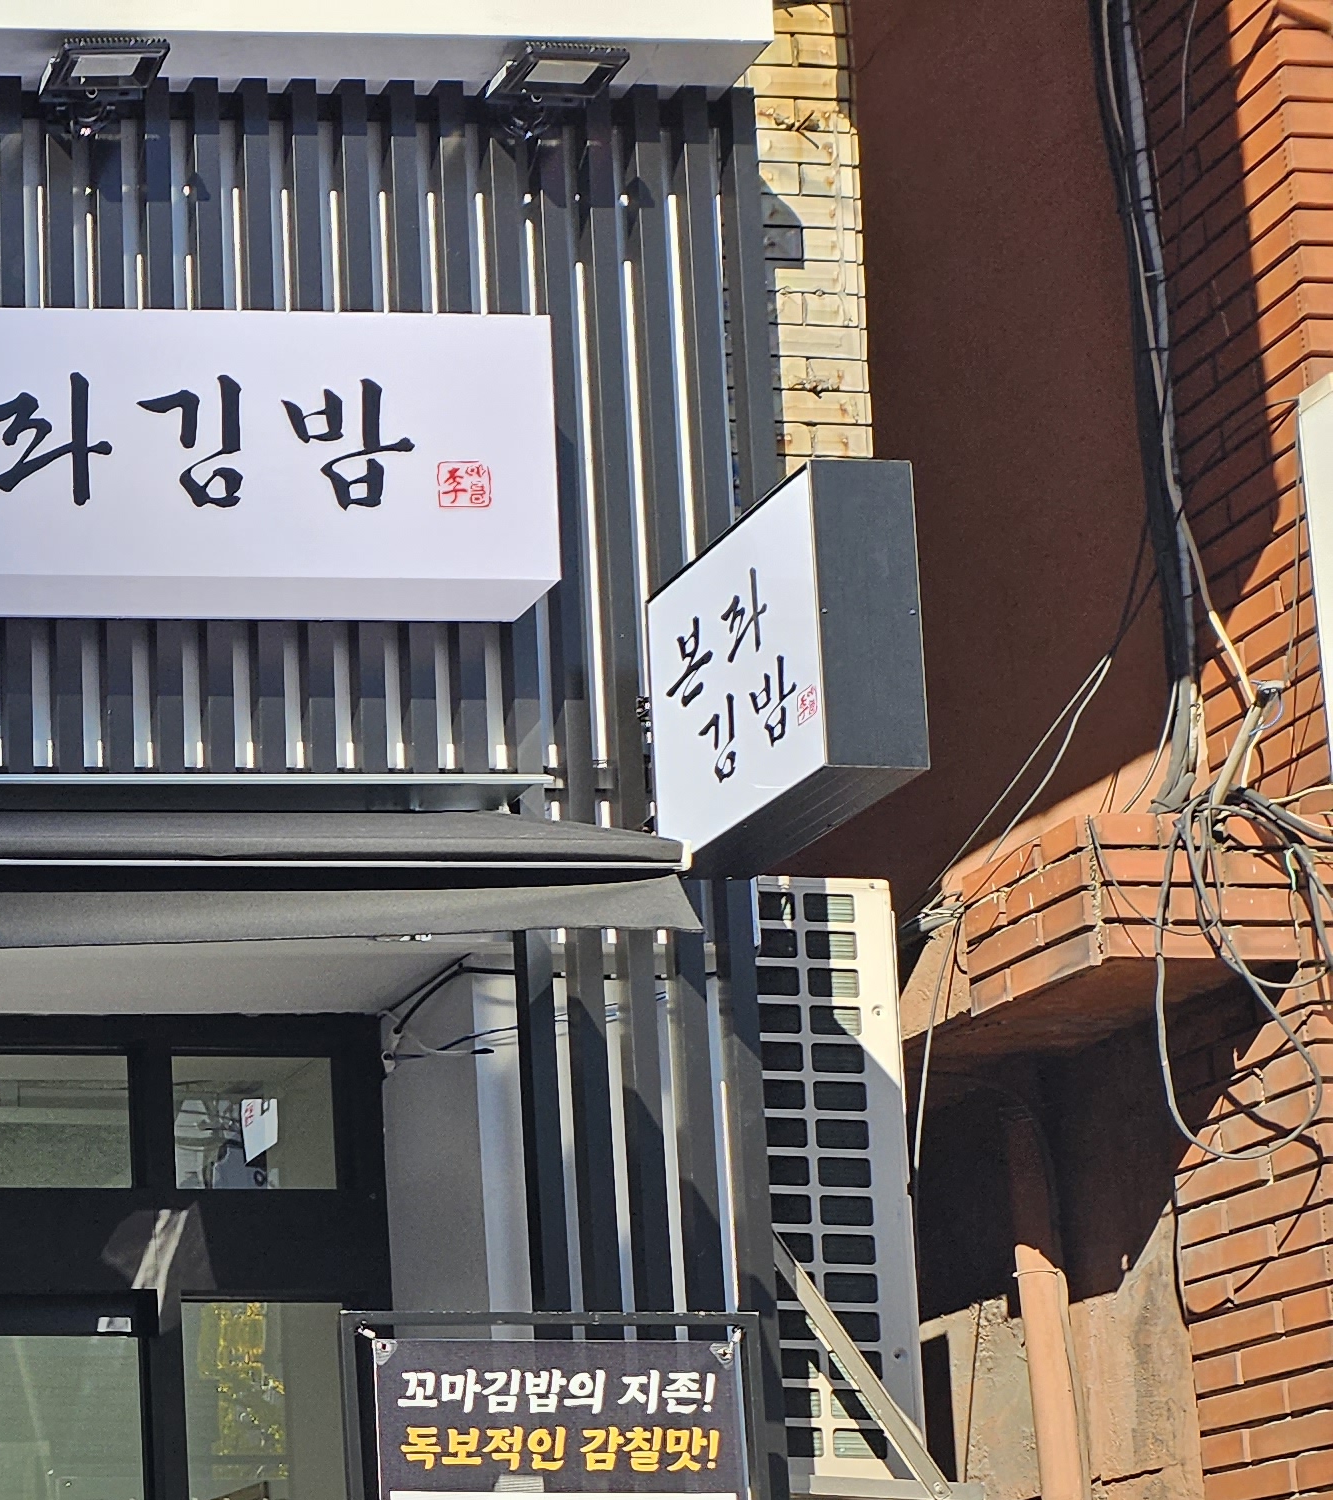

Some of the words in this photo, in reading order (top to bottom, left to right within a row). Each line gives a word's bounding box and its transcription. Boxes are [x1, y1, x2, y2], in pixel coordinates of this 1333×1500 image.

[698, 654, 797, 784] 김밥
[397, 1369, 606, 1415] 꼬마김밥의
[616, 1369, 717, 1414] 지존!
[399, 1425, 566, 1471] 독보적인
[579, 1425, 720, 1471] 감칠맛!
